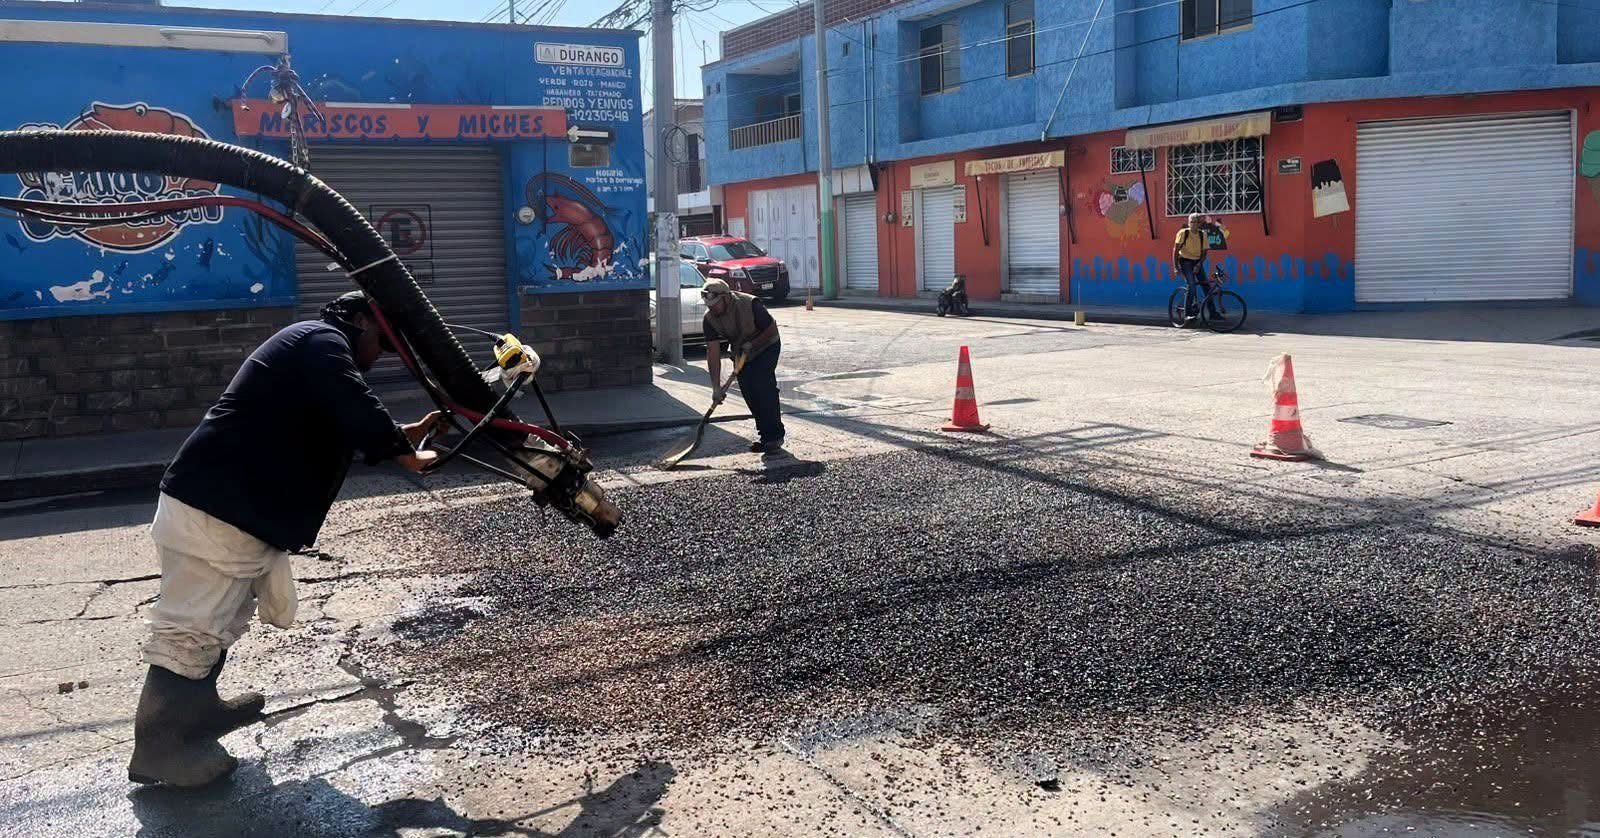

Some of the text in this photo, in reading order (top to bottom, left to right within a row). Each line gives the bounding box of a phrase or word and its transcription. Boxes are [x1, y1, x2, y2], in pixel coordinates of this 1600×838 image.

[559, 49, 619, 64] DURANGO
[551, 66, 584, 76] VENTA
[538, 77, 567, 86] VERDE
[542, 96, 634, 110] PEDIDOS Y ENVIOS
[258, 111, 545, 135] MRISCOS Y MICHES
